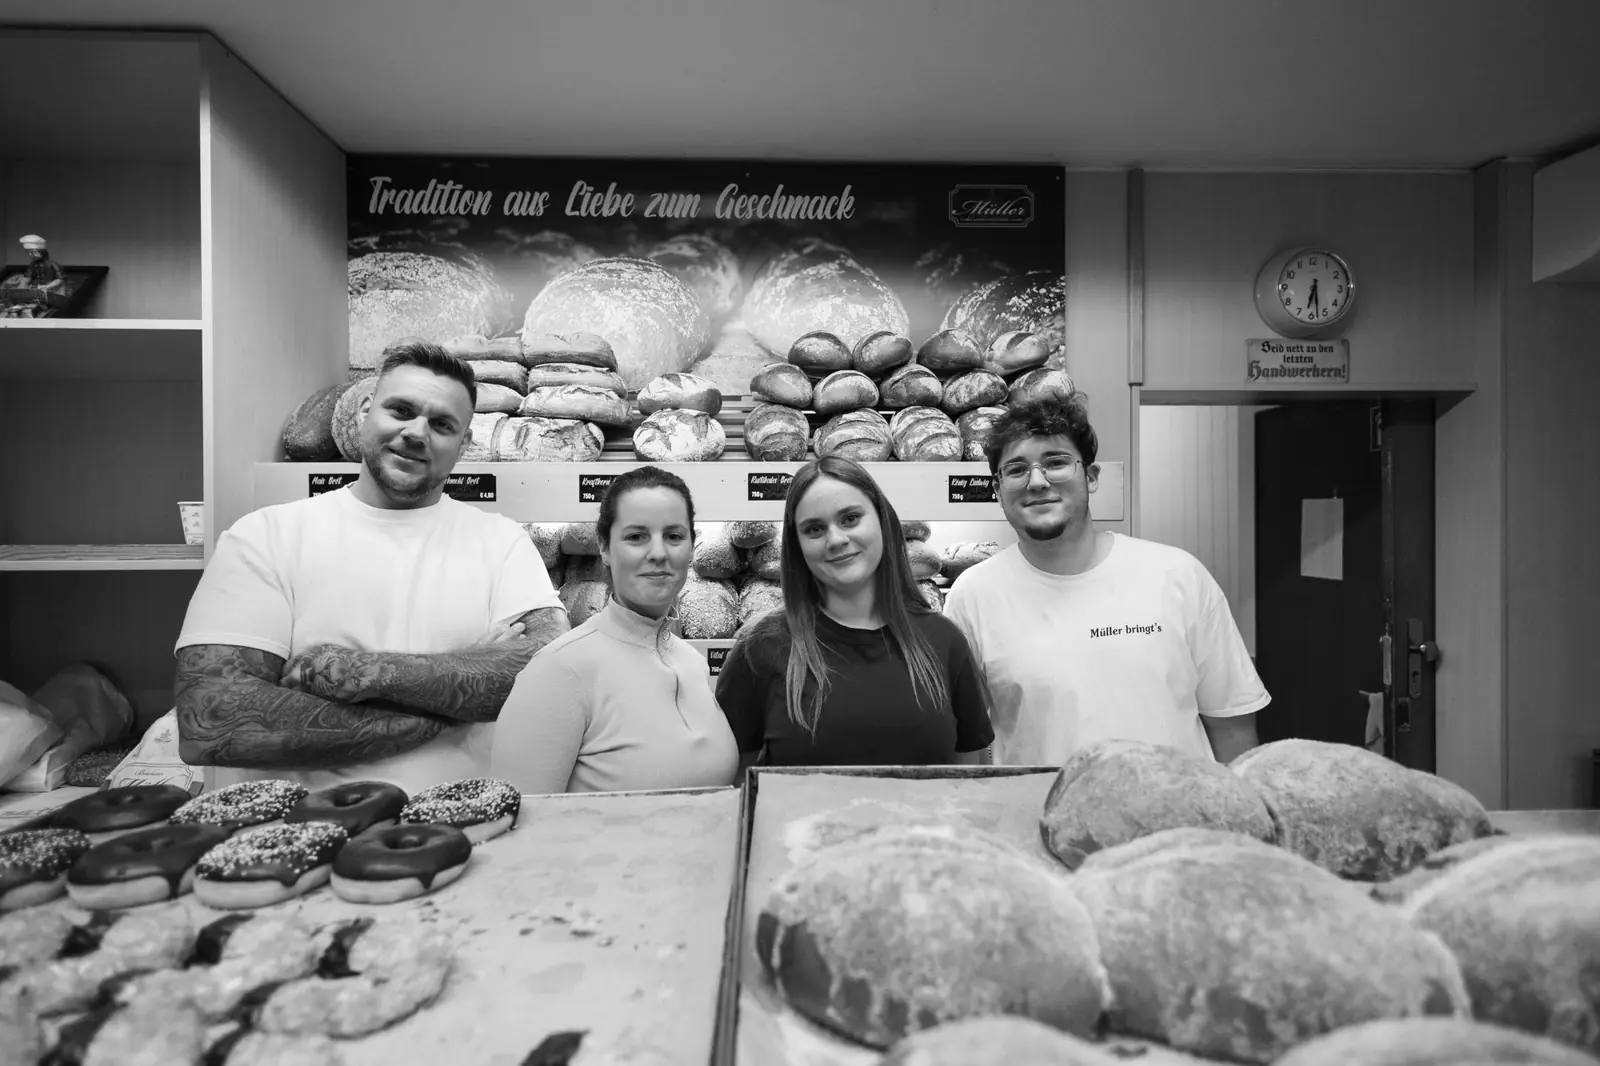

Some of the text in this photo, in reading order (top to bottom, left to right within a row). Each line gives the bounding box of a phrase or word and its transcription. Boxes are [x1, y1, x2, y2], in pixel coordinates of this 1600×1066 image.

[369, 176, 855, 220] Tradition aus Liebe zum Geschmack
[952, 196, 1031, 216] Müller
[1297, 260, 1303, 269] 11
[1309, 257, 1318, 266] 12
[1286, 270, 1295, 280] 10
[1333, 270, 1339, 280] 2
[1281, 284, 1288, 292] 9
[1337, 284, 1343, 293] 3
[1285, 298, 1291, 306] 8
[1332, 299, 1338, 307] 4
[1296, 307, 1302, 316] 7
[1308, 312, 1315, 320] 6
[1322, 307, 1328, 317] 5
[1261, 341, 1334, 353] Seid nett zu den
[1283, 354, 1314, 364] letzten
[1247, 360, 1346, 381] Handwerkern!
[328, 476, 343, 485] Brot
[466, 476, 480, 485] Brot
[969, 478, 990, 488] Ludwig
[1090, 622, 1162, 639] Müller bringt's
